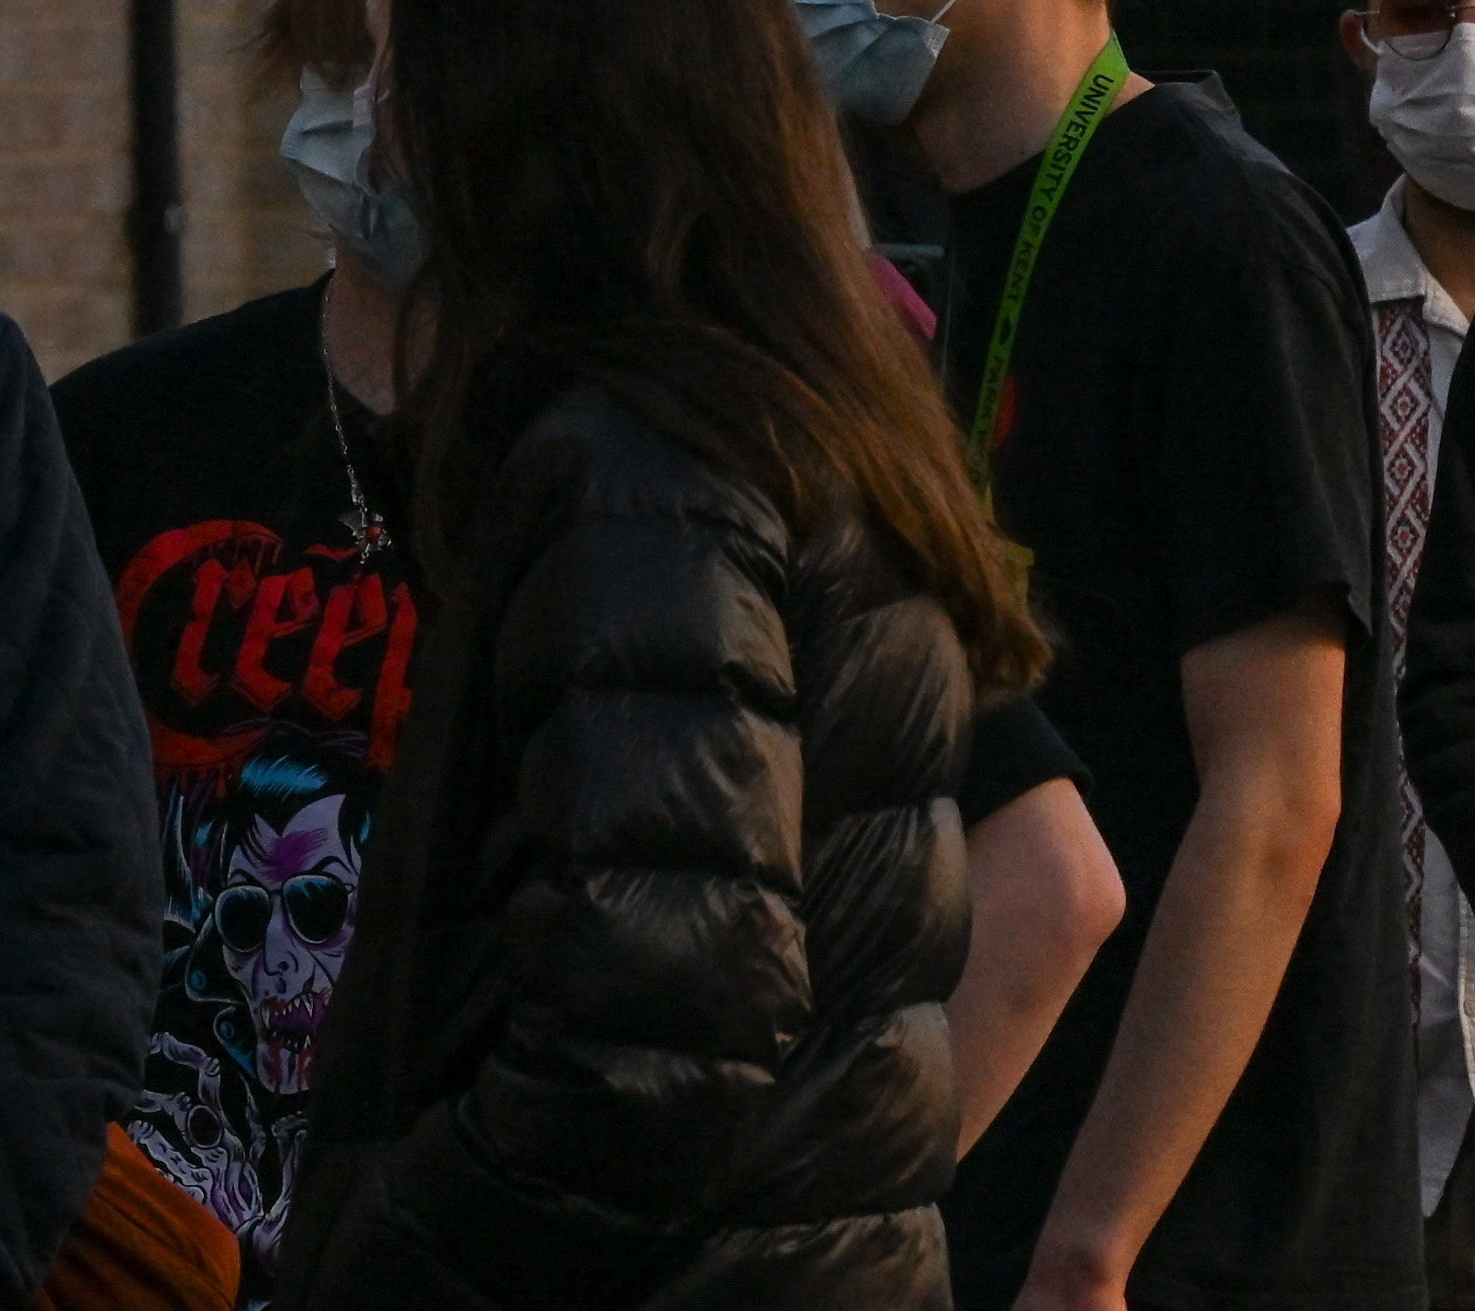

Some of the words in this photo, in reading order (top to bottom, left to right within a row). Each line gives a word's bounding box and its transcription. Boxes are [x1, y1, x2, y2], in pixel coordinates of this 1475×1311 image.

[1037, 73, 1114, 202] UNIVERSITY
[1028, 204, 1047, 233] OF
[1007, 239, 1035, 302] KENT
